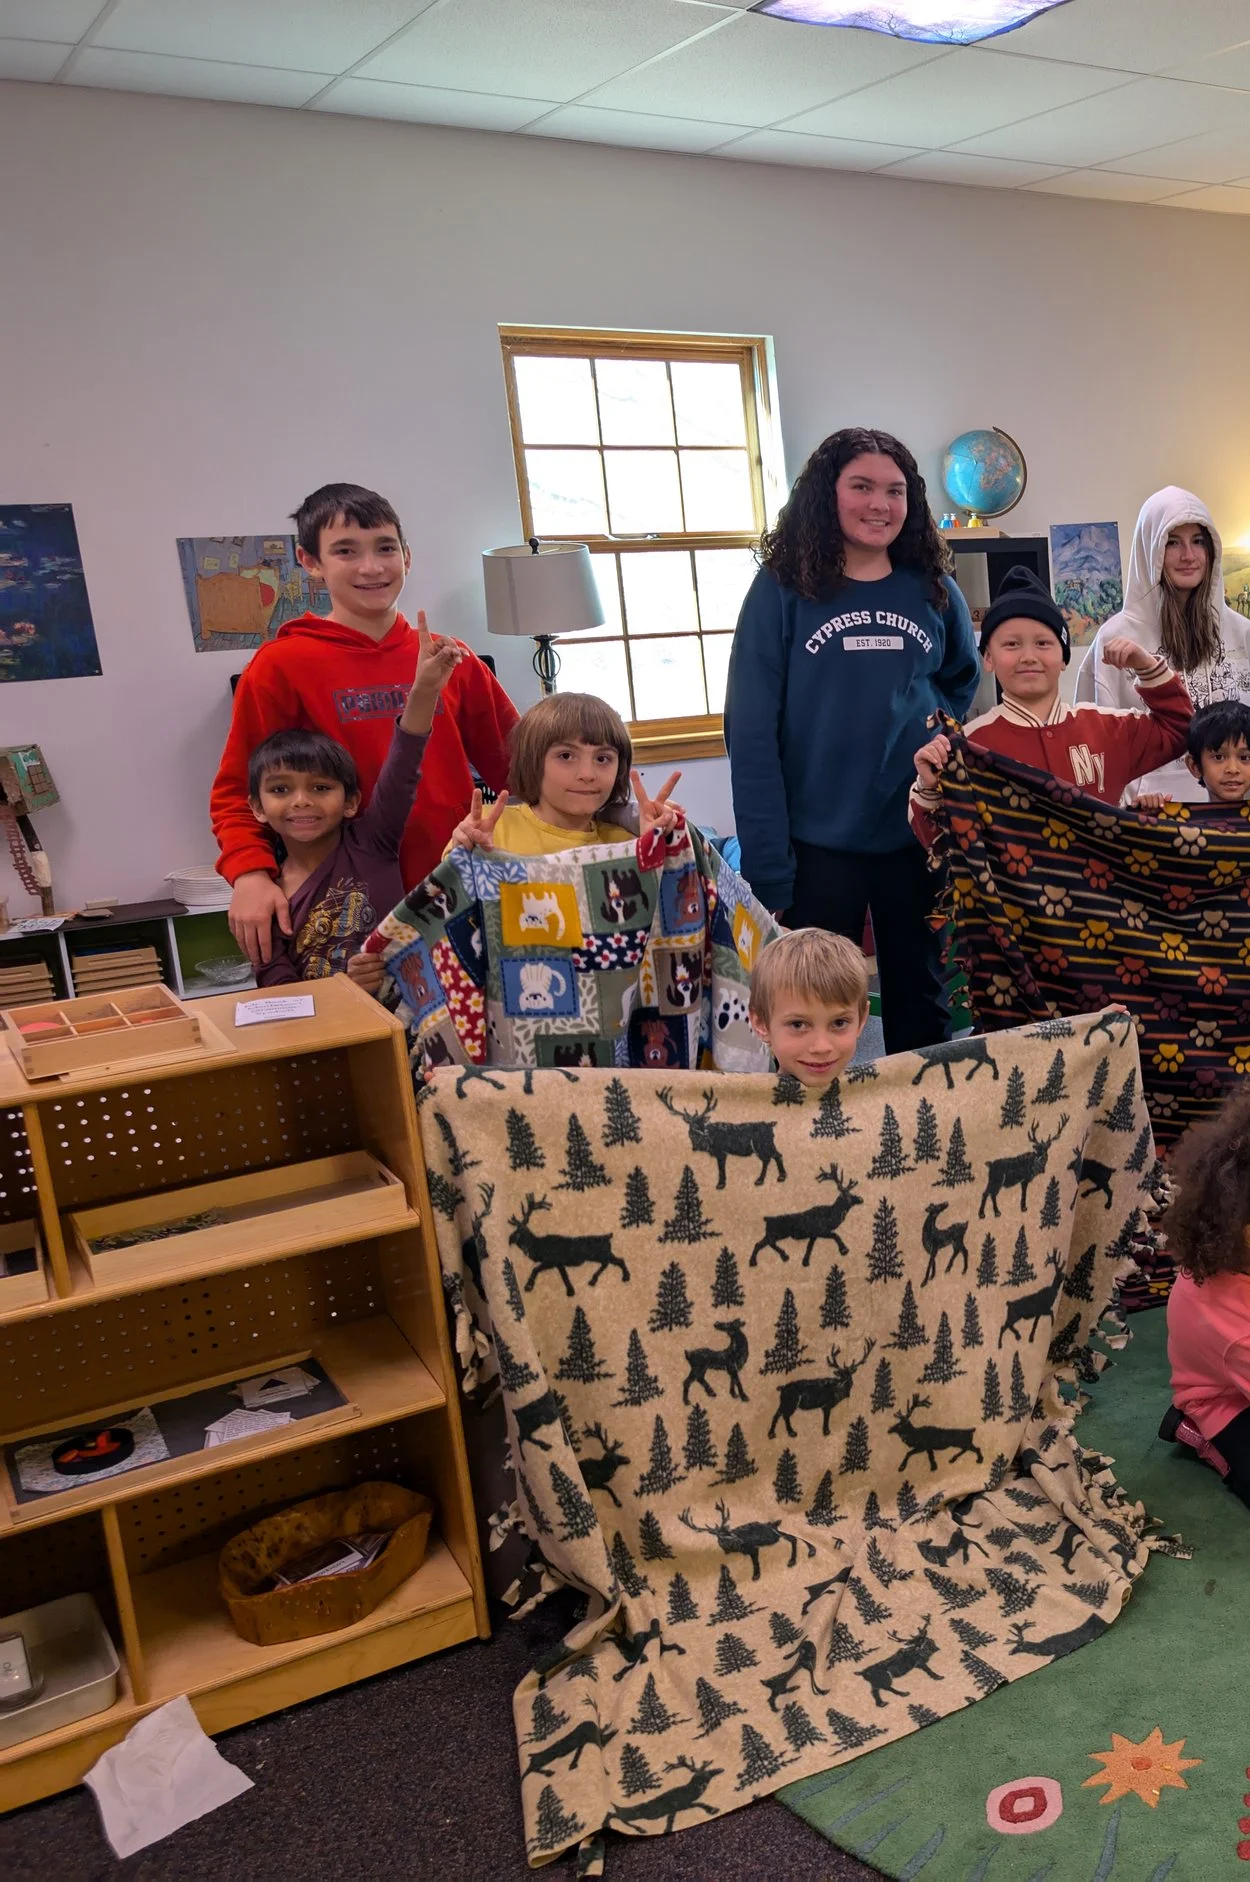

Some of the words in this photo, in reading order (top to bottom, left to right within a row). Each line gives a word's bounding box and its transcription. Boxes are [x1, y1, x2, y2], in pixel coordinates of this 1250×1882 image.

[805, 610, 872, 654] CYPRESS
[875, 611, 933, 653] CHURCH
[856, 639, 871, 647] EST.
[875, 638, 891, 647] 1920
